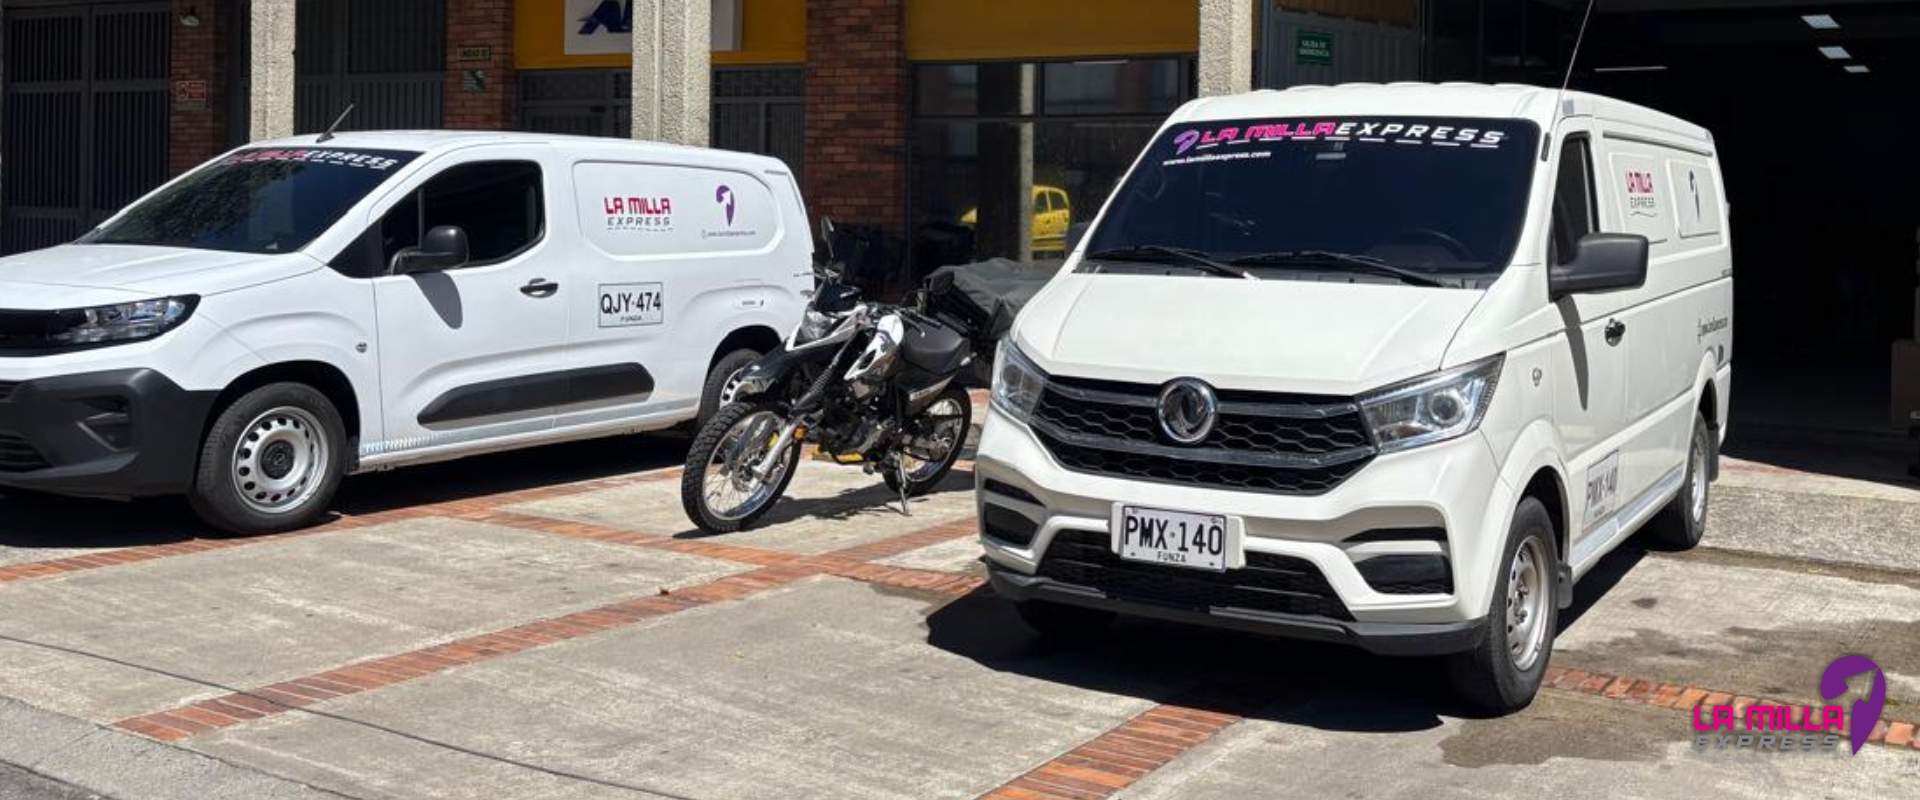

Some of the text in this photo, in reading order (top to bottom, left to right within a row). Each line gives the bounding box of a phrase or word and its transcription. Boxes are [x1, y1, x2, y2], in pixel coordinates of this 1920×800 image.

[1201, 128, 1239, 144] LA
[604, 196, 671, 215] LA MILLA
[607, 216, 670, 226] EXPRESS
[1157, 551, 1187, 563] FUNZA
